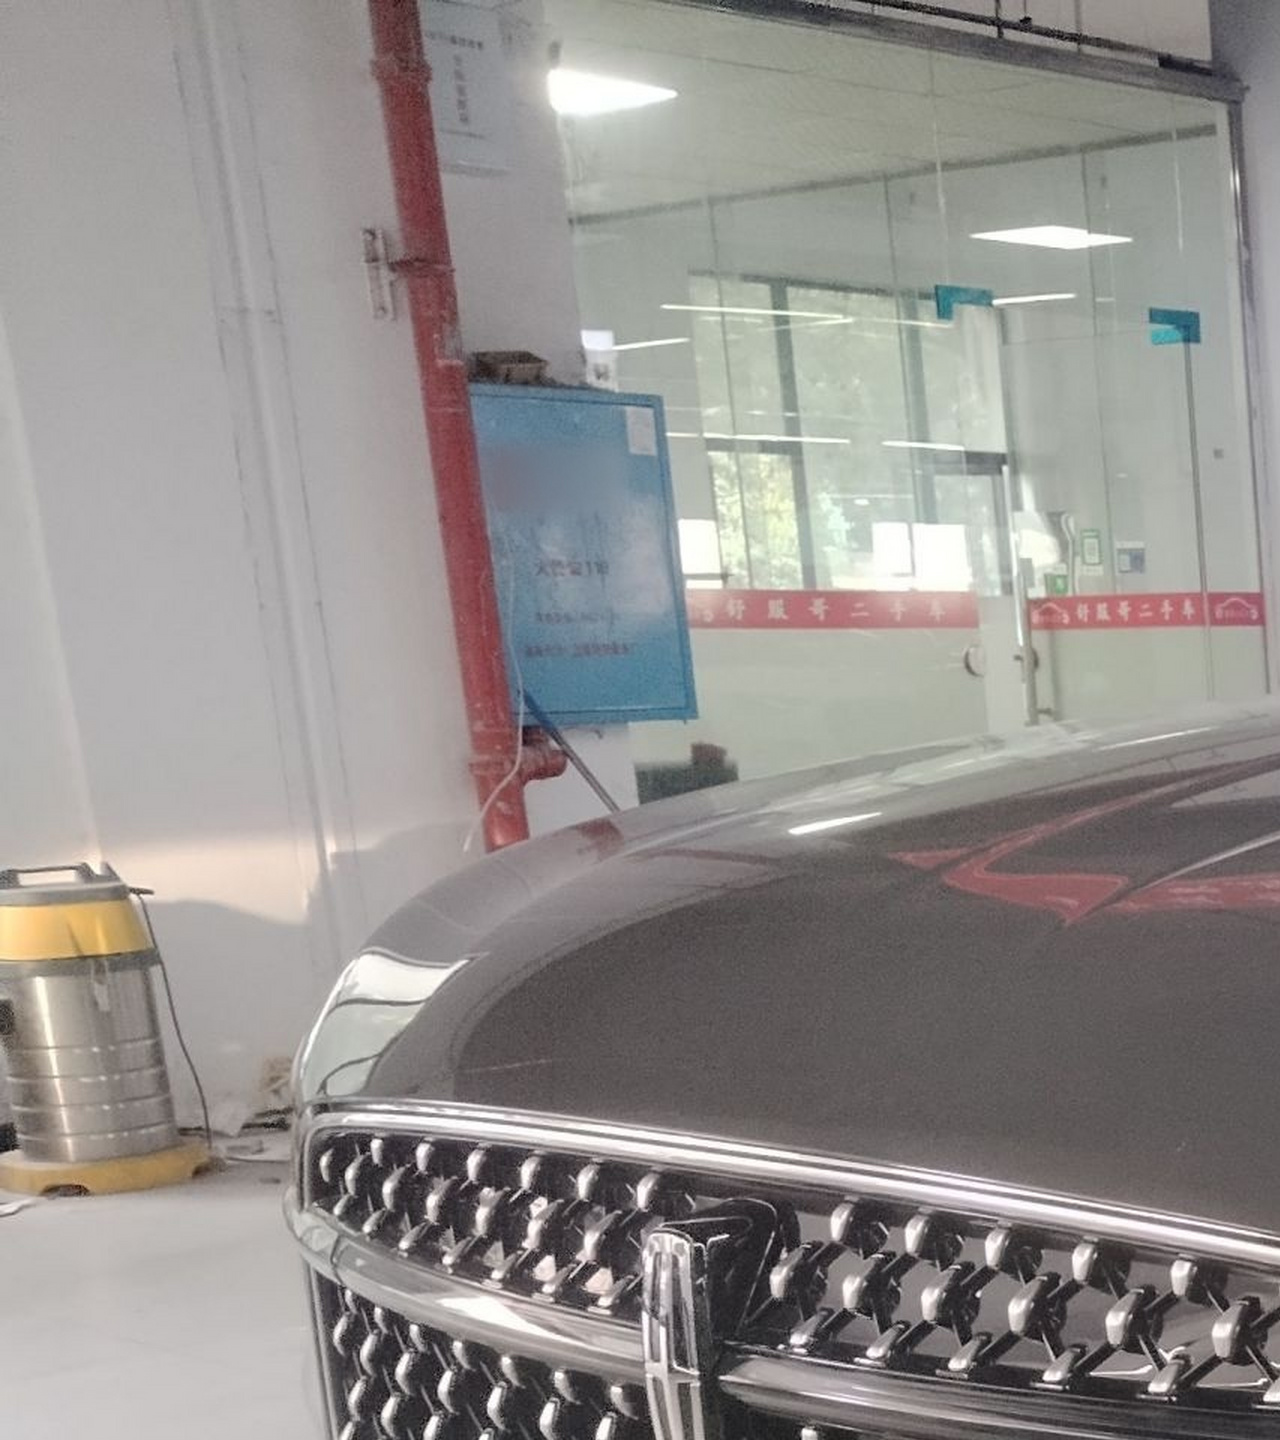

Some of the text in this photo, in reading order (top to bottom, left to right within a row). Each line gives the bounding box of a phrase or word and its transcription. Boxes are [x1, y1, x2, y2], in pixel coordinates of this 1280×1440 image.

[1076, 599, 1195, 622] 舒服哥二手车
